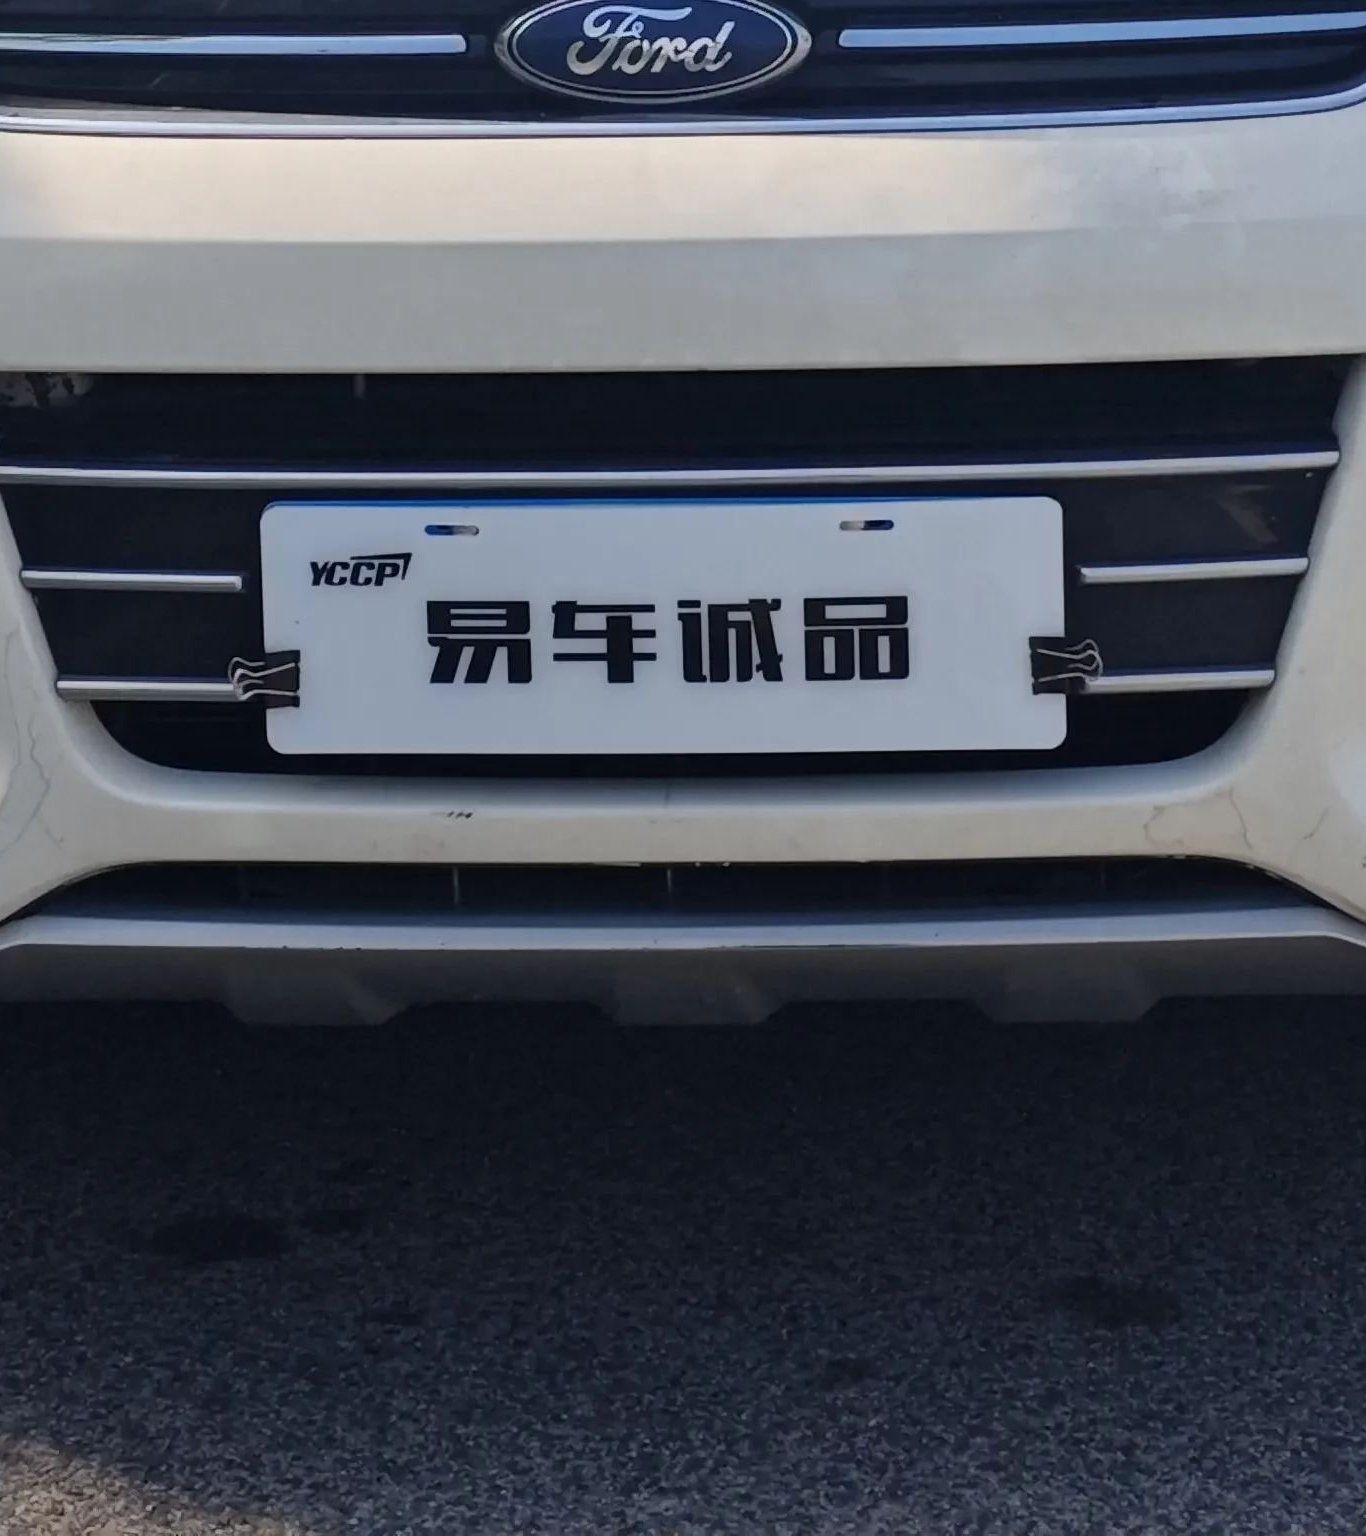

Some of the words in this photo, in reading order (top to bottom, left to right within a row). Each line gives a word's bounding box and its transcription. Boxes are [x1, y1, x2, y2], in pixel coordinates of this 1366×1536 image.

[566, 5, 735, 75] Ford
[309, 555, 409, 587] YCCP
[426, 596, 910, 684] 易车诚品
